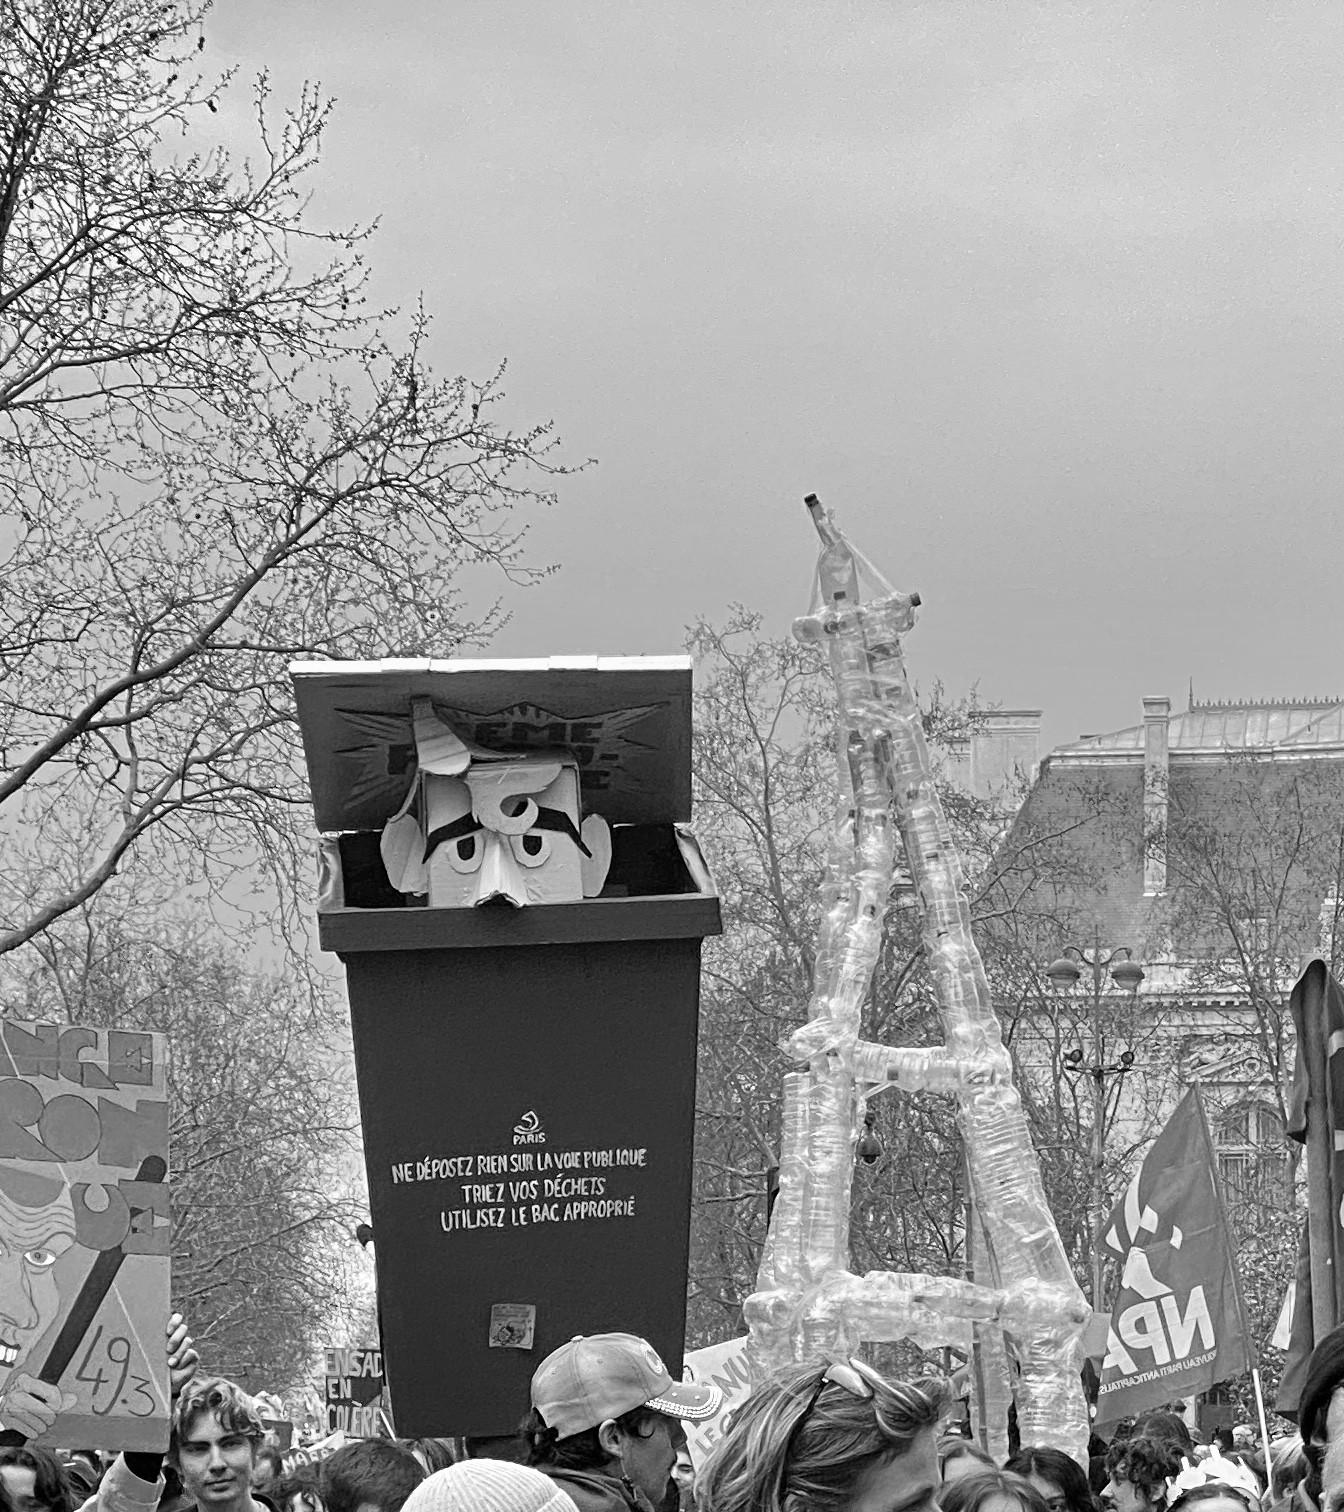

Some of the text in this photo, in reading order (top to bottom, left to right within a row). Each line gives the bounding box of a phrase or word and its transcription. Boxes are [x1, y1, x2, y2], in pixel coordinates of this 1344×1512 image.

[513, 1132, 546, 1145] PARIS
[392, 1148, 647, 1184] NE DÉPOSEZ RIEN SUR LA VOIE PUBLIQUE
[461, 1173, 606, 1204] TRIEZ VOS DÉCHETS
[441, 1195, 636, 1232] UTILISEZ LE BAC APPROPRIÉ
[76, 1325, 156, 1417] 49.3
[328, 1378, 352, 1399] EN
[327, 1400, 382, 1438] COLÈRE
